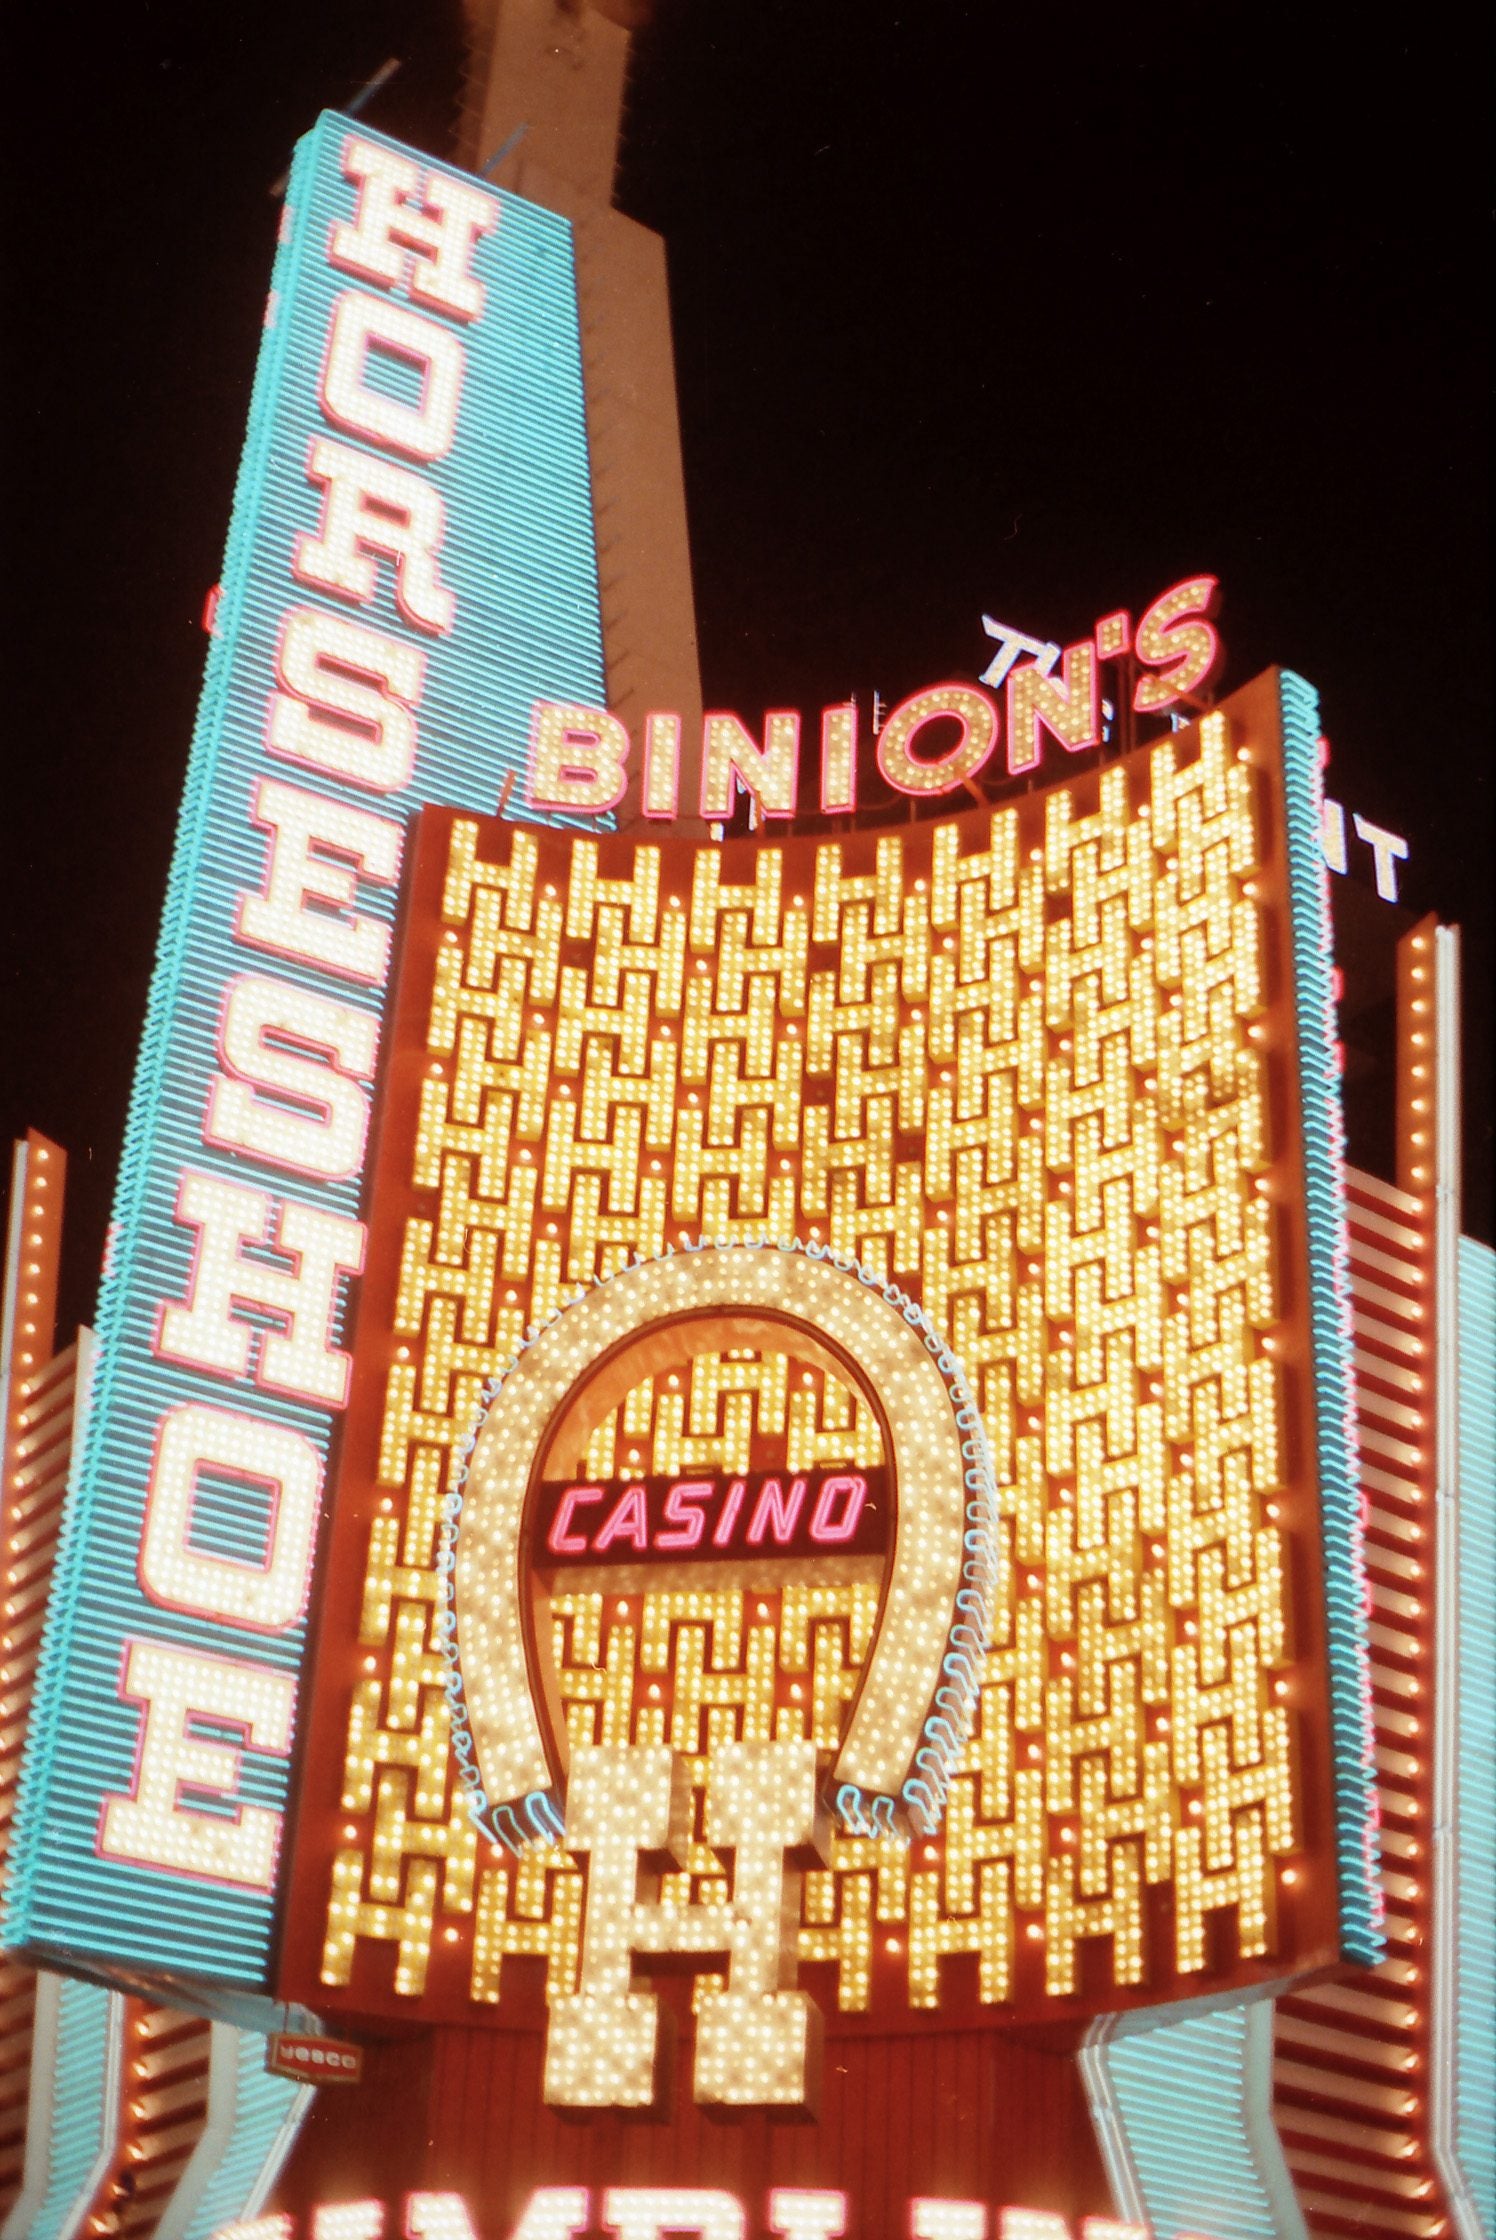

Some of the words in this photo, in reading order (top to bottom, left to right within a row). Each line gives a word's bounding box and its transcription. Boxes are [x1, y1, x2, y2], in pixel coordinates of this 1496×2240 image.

[524, 573, 1219, 818] BINION'S
[95, 133, 502, 1894] HORSESHOE
[546, 1473, 868, 1555] CASINO
